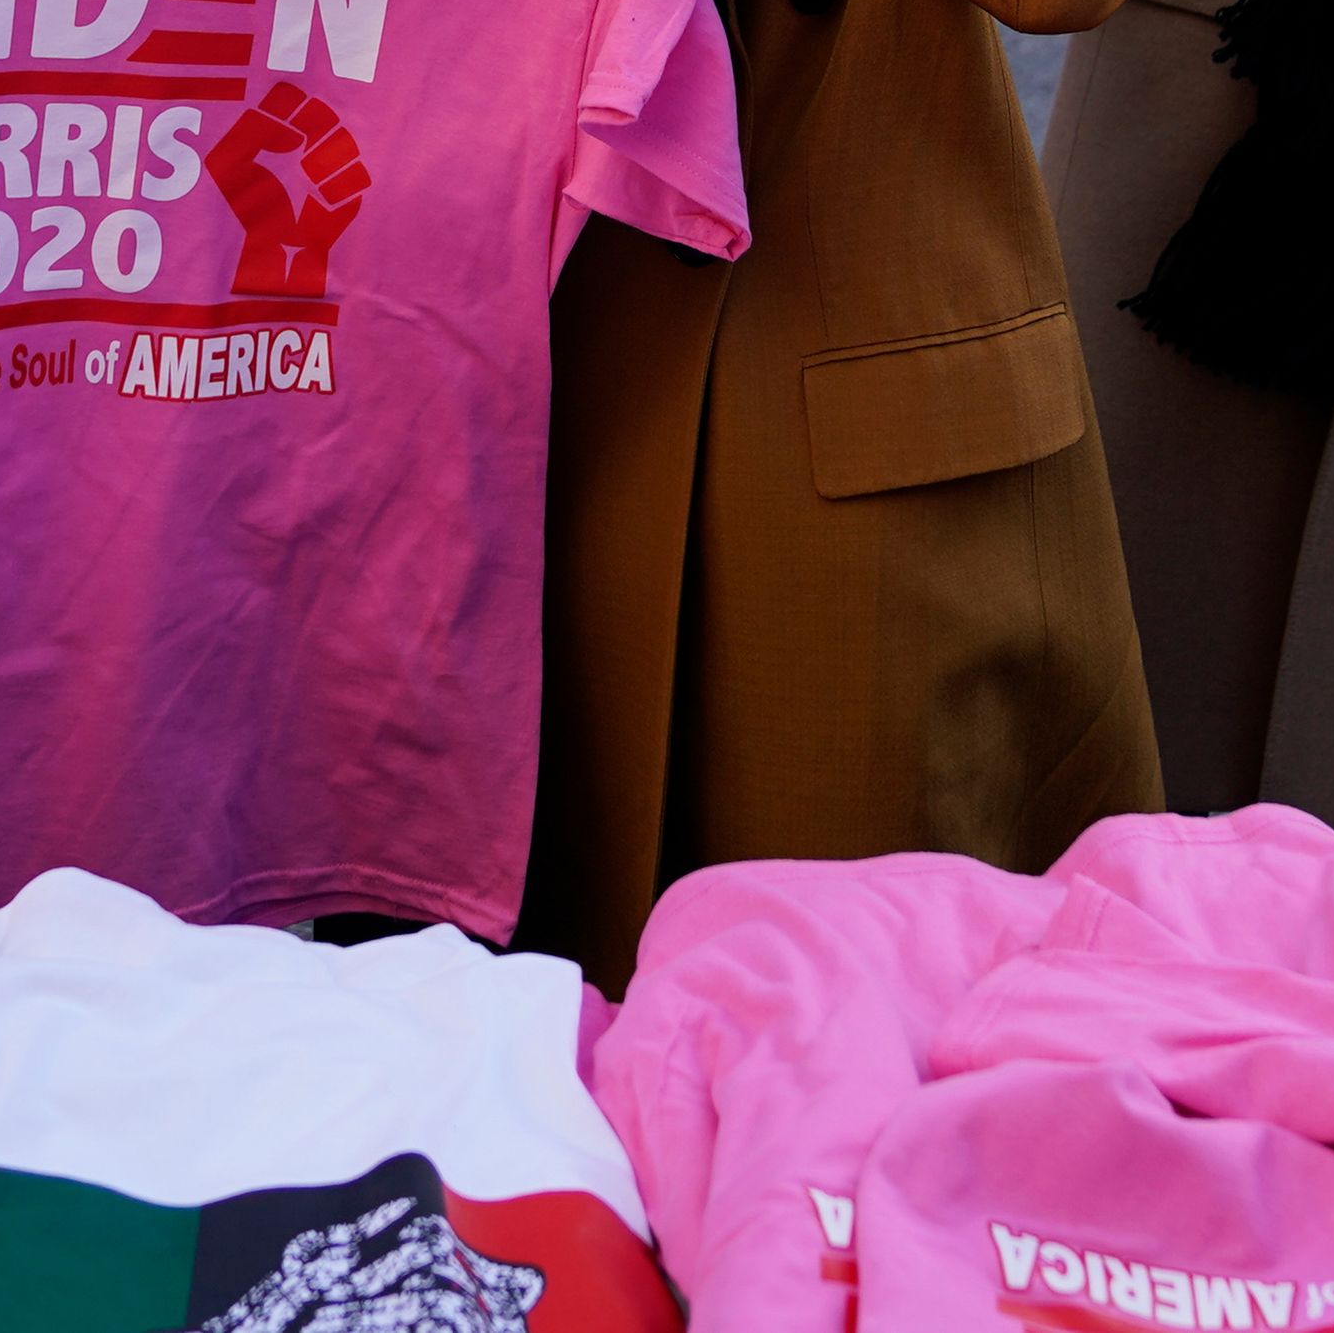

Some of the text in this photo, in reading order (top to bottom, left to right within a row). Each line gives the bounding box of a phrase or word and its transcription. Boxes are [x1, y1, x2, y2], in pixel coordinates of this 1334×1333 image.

[8, 338, 77, 389] Soul
[84, 340, 122, 385] of
[120, 329, 334, 402] AMERICA
[989, 1221, 1299, 1330] AMERICA
